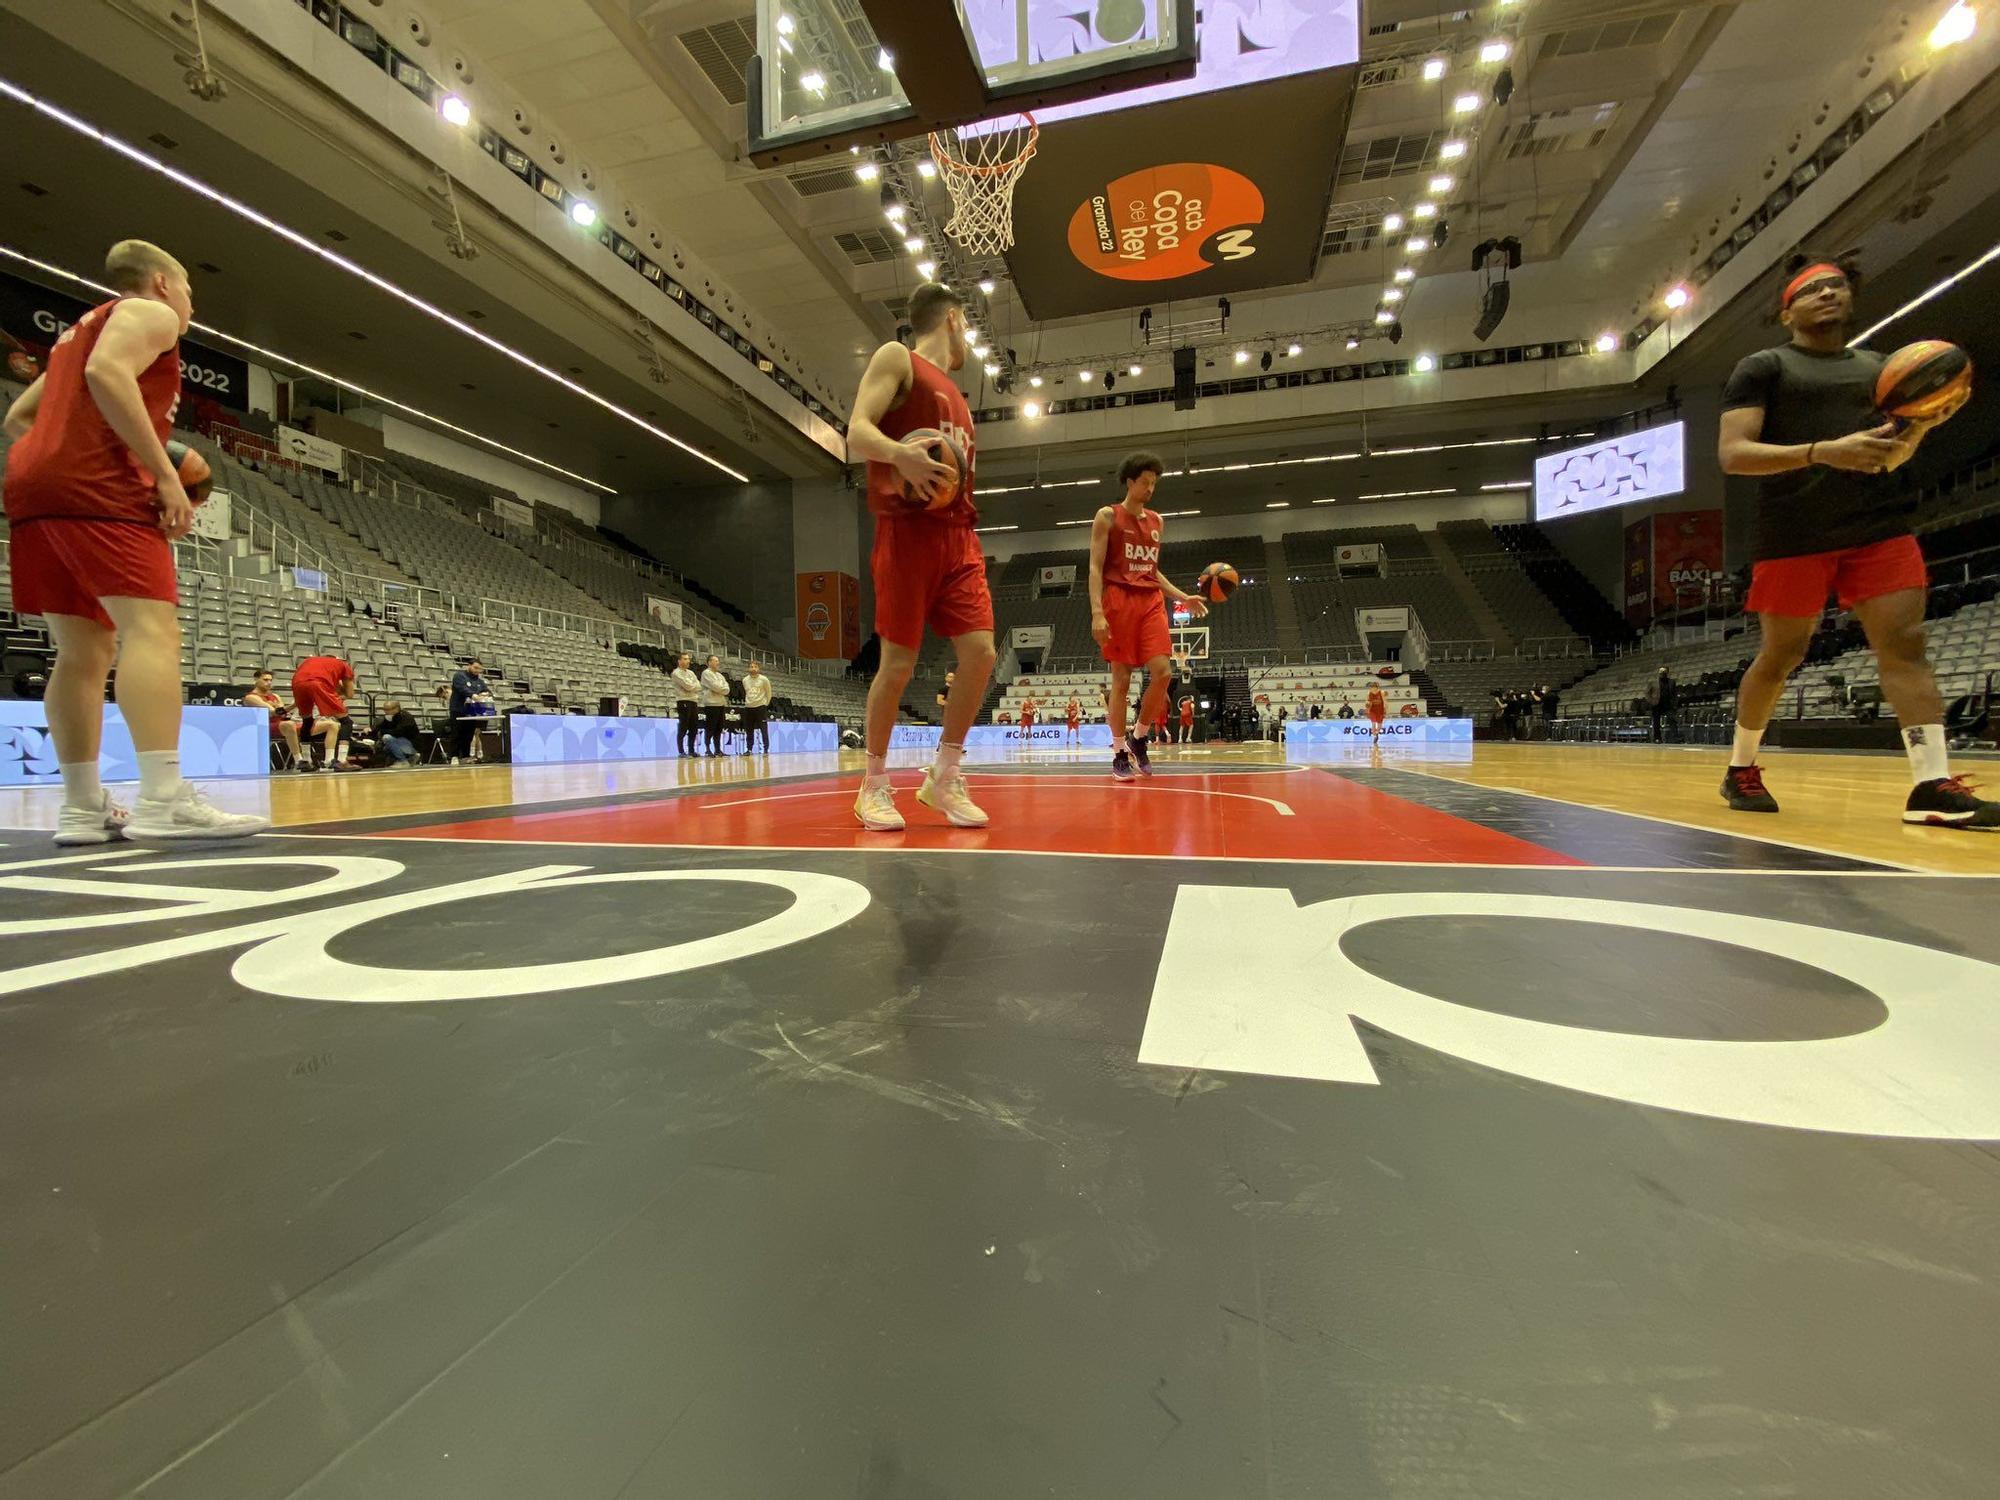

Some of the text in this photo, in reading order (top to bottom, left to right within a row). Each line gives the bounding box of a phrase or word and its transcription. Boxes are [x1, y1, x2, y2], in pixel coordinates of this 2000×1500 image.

[1092, 195, 1112, 239] Granada
[1119, 199, 1149, 260] del Rey
[1150, 189, 1183, 250] Copa
[1184, 198, 1206, 231] acb
[223, 698, 243, 706] ac
